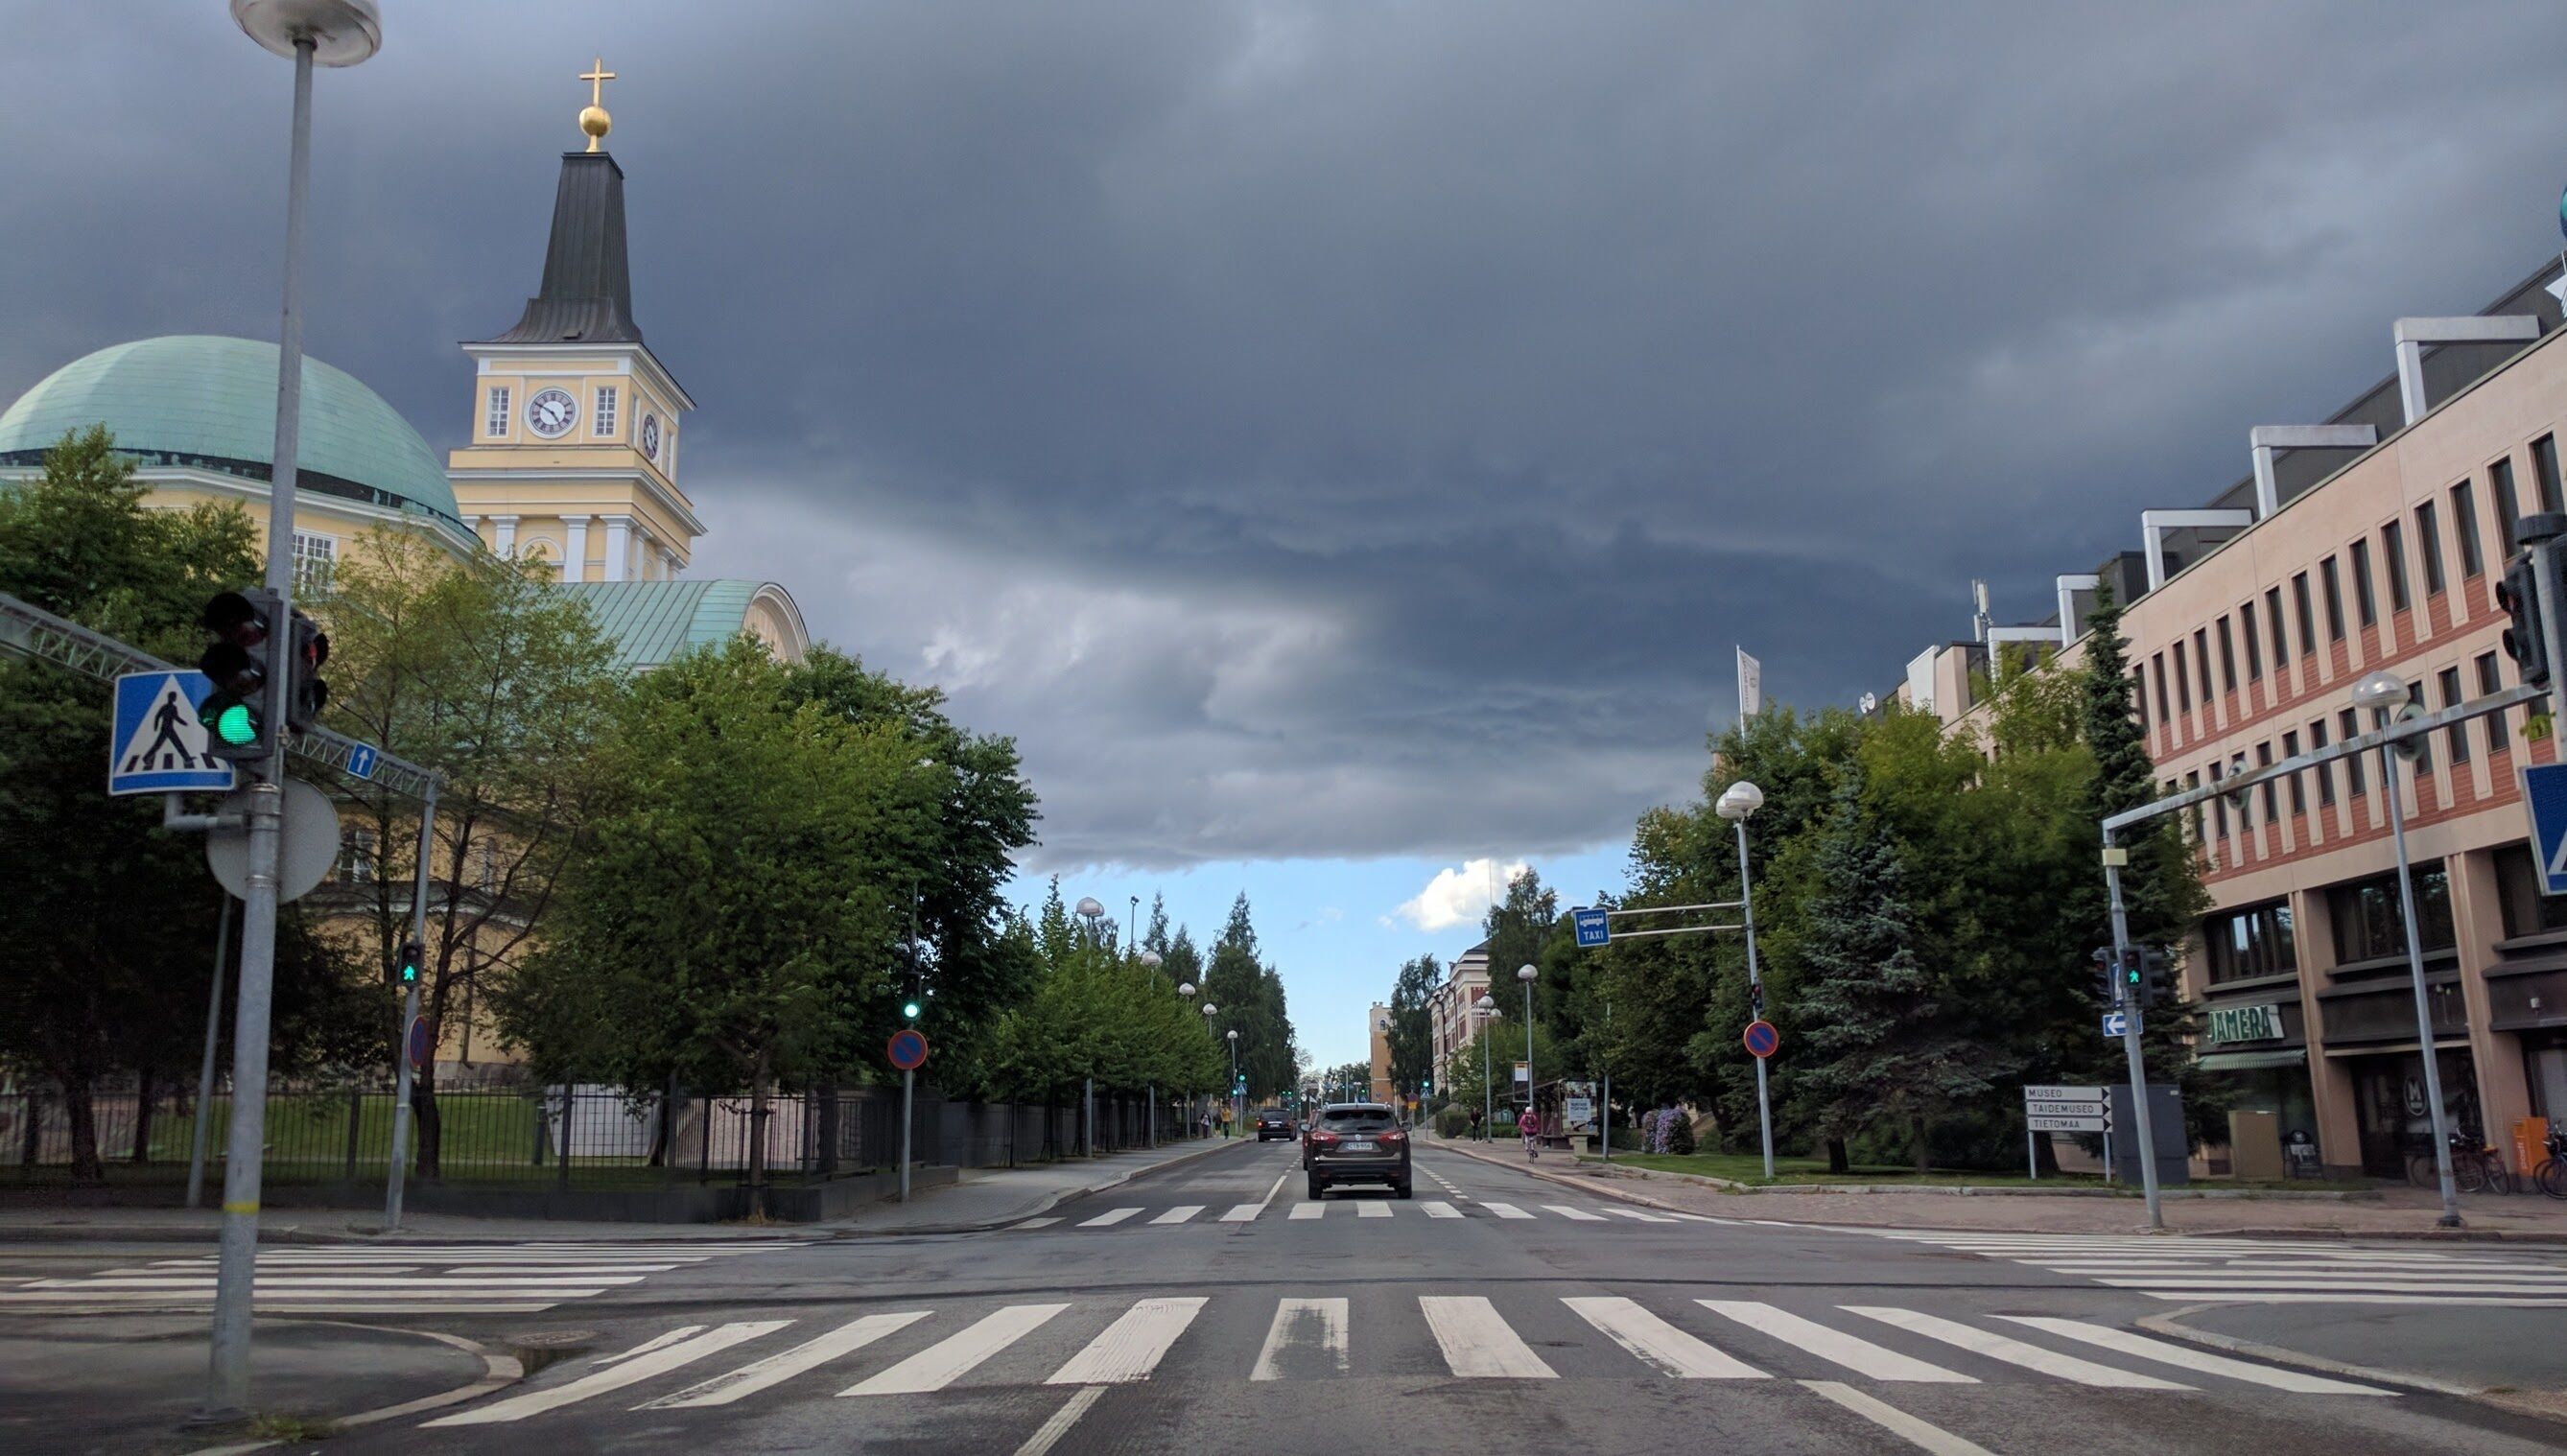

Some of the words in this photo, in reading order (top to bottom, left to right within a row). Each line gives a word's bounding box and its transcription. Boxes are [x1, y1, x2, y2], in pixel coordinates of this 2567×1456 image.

[1583, 930, 1604, 941] TAXI
[2028, 1089, 2062, 1098] MUSEO
[2034, 1104, 2094, 1114] TAIDEMUSEO
[2034, 1119, 2080, 1129] TIETOMAA
